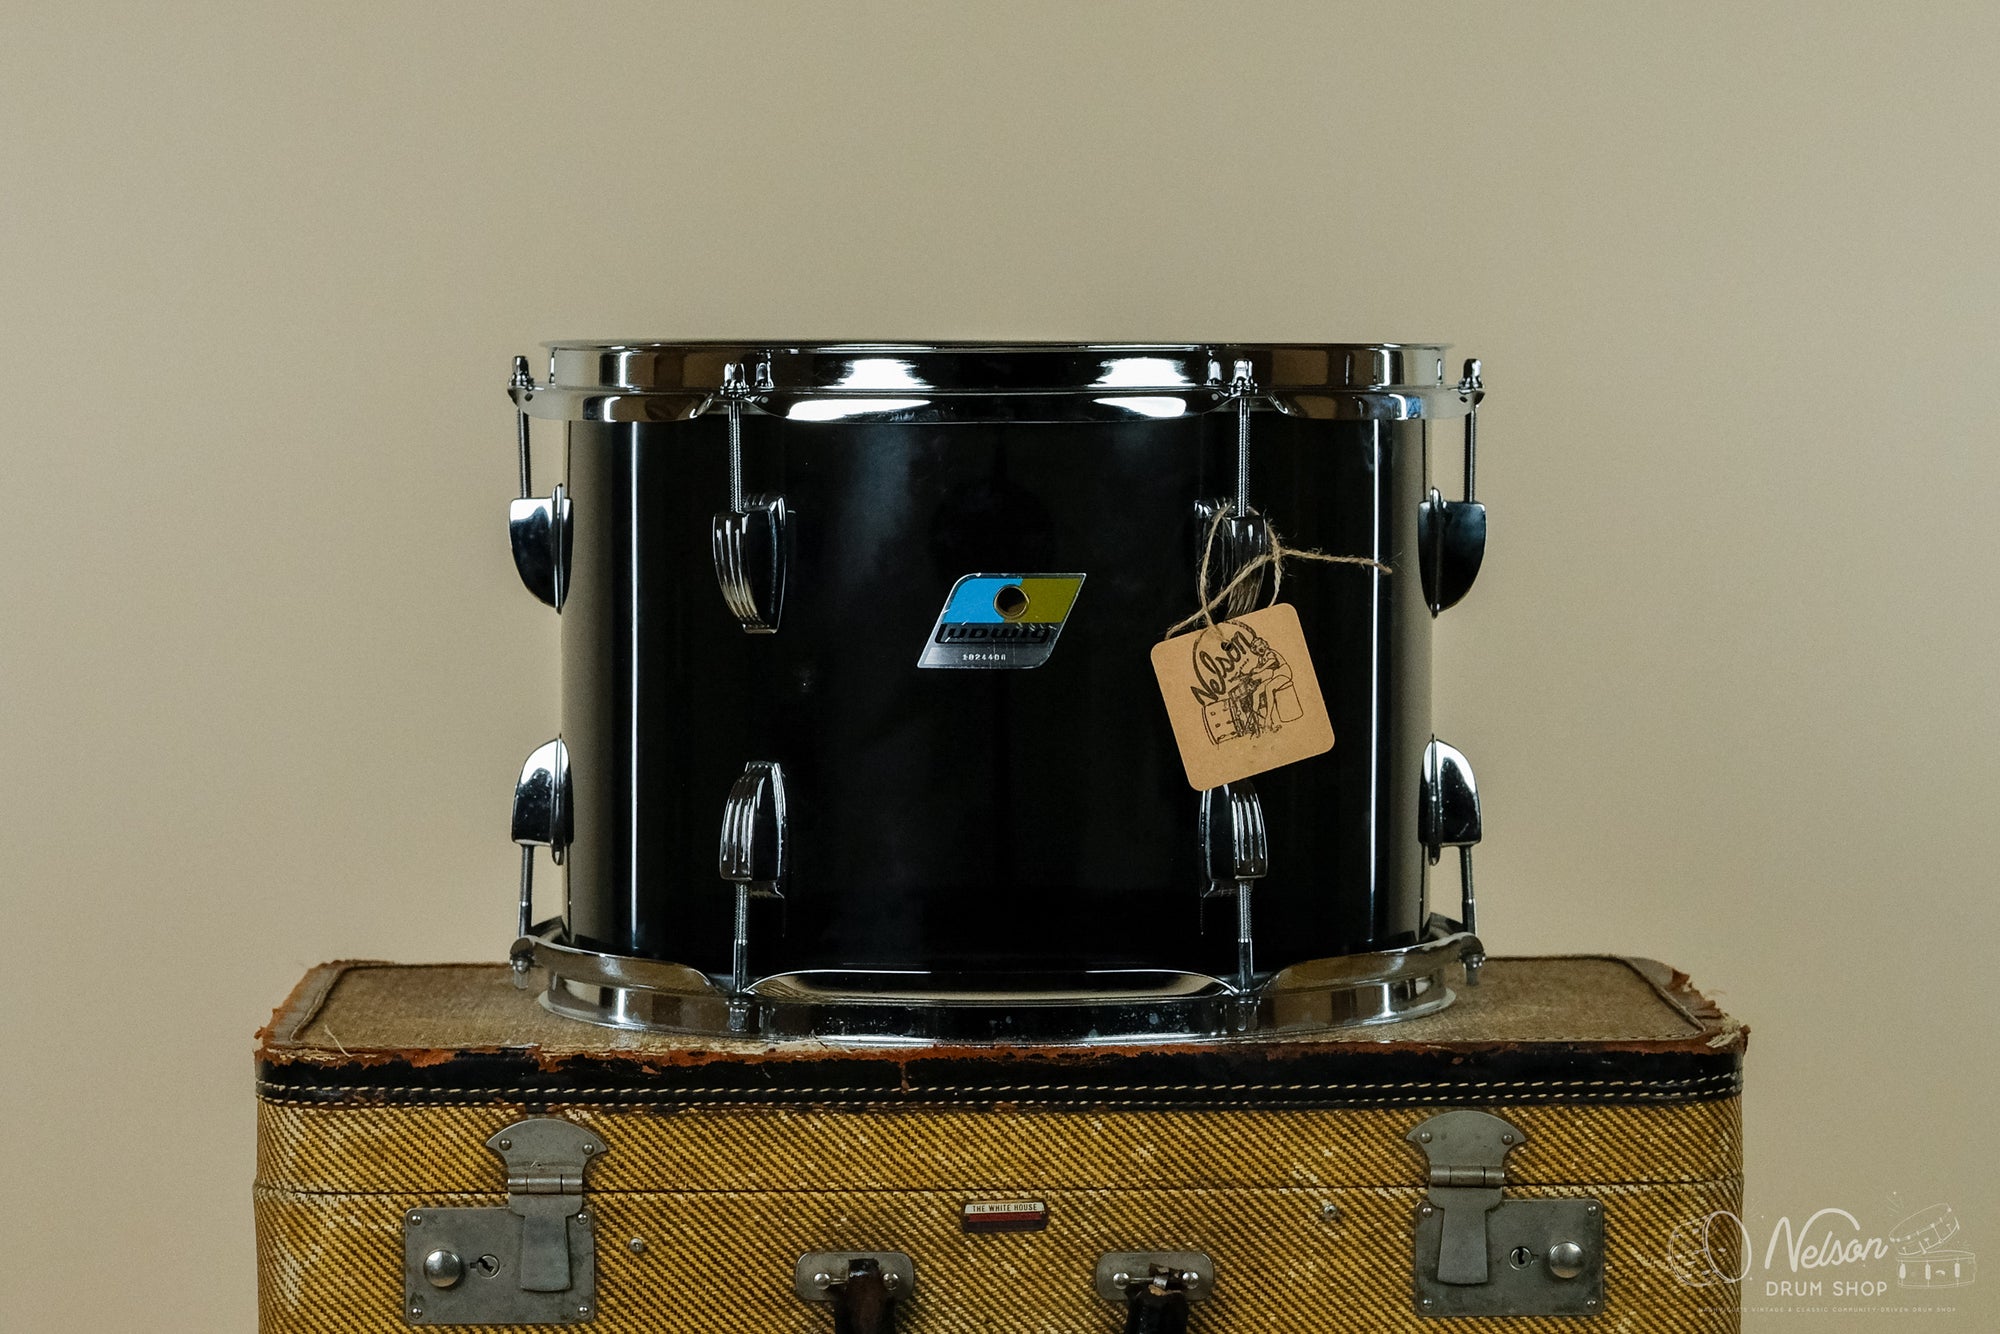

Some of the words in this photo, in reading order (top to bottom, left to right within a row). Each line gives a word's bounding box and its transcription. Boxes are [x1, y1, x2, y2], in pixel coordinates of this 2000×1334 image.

[1190, 621, 1256, 706] Nelson
[972, 1205, 985, 1213] THE
[1014, 1203, 1037, 1211] HOUSE
